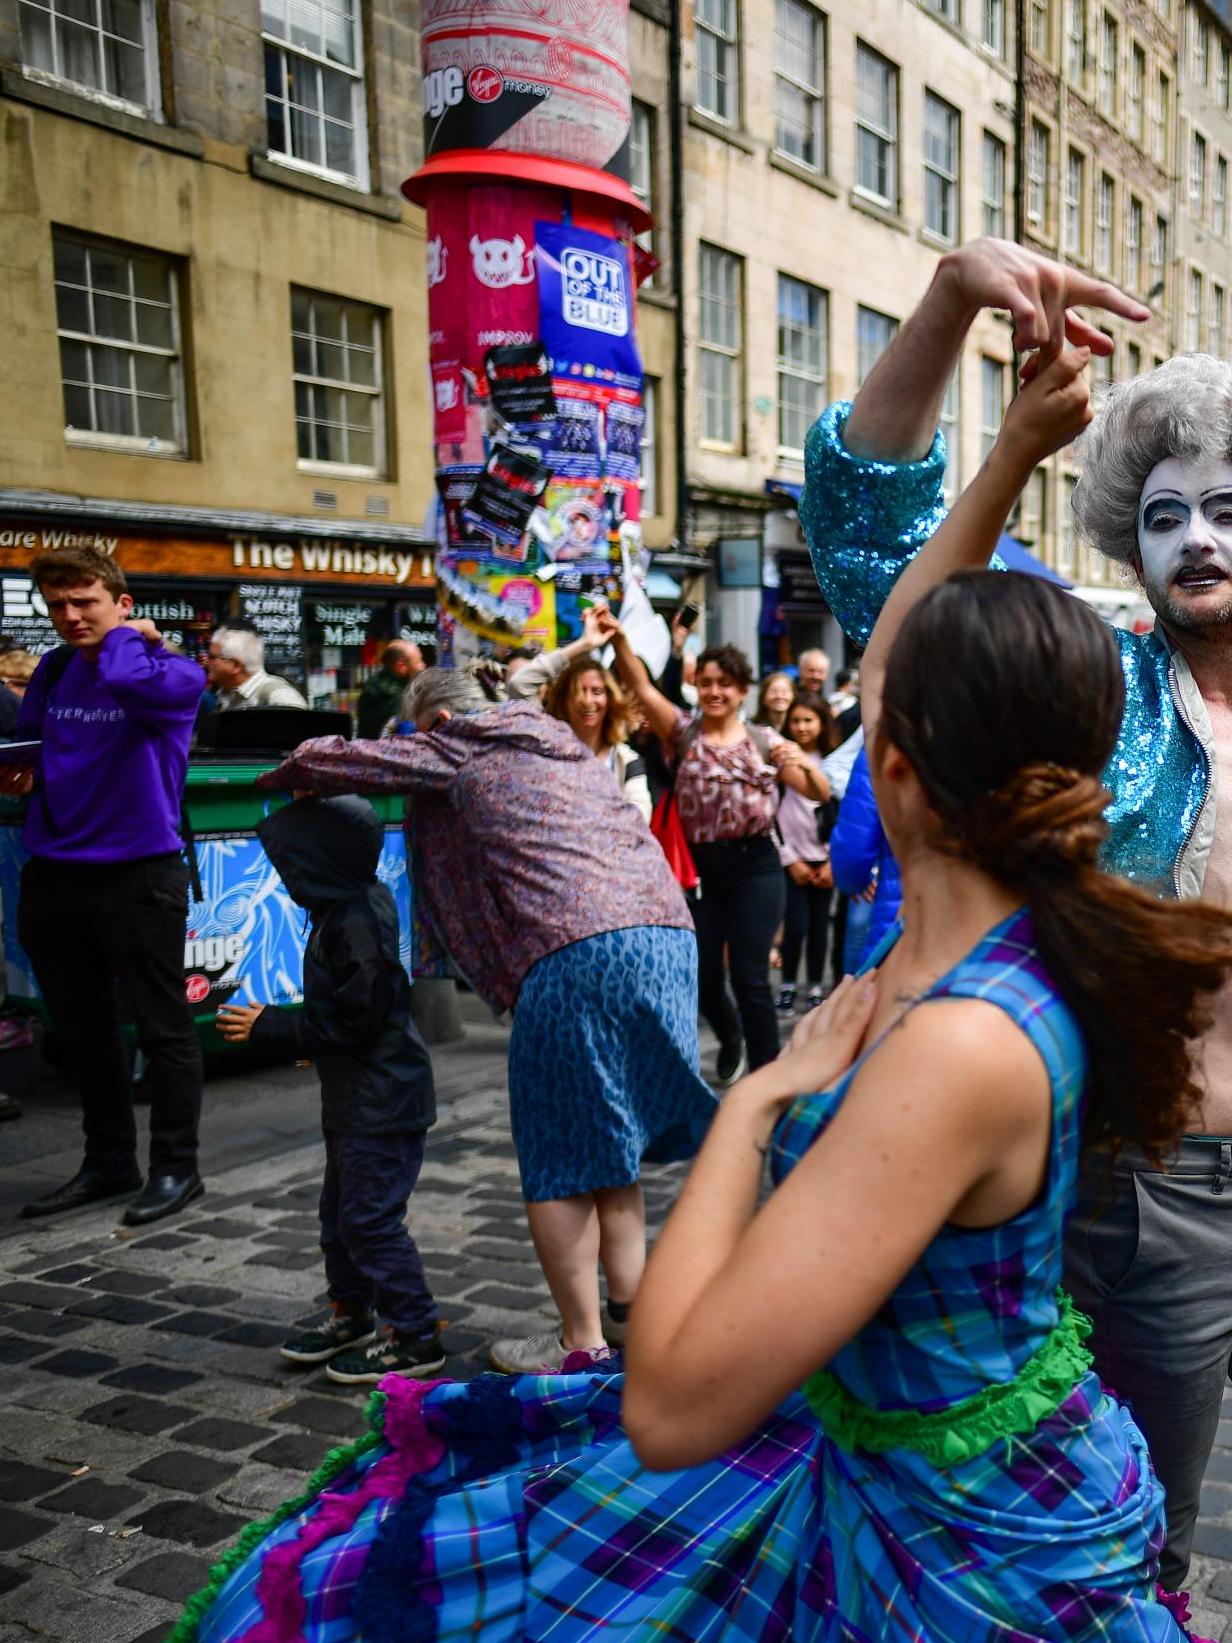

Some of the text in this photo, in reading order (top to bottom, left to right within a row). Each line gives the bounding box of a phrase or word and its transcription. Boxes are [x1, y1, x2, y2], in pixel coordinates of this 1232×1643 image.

[504, 80, 552, 100] money
[566, 254, 621, 291] OUT
[568, 280, 624, 308] OF THE
[570, 301, 623, 330] BLUE
[0, 529, 118, 556] are Whisky
[228, 535, 294, 570] The
[301, 539, 412, 584] Whisky
[130, 600, 194, 620] ottish
[315, 601, 373, 628] Single
[322, 625, 366, 646] Malt
[184, 936, 244, 971] nge
